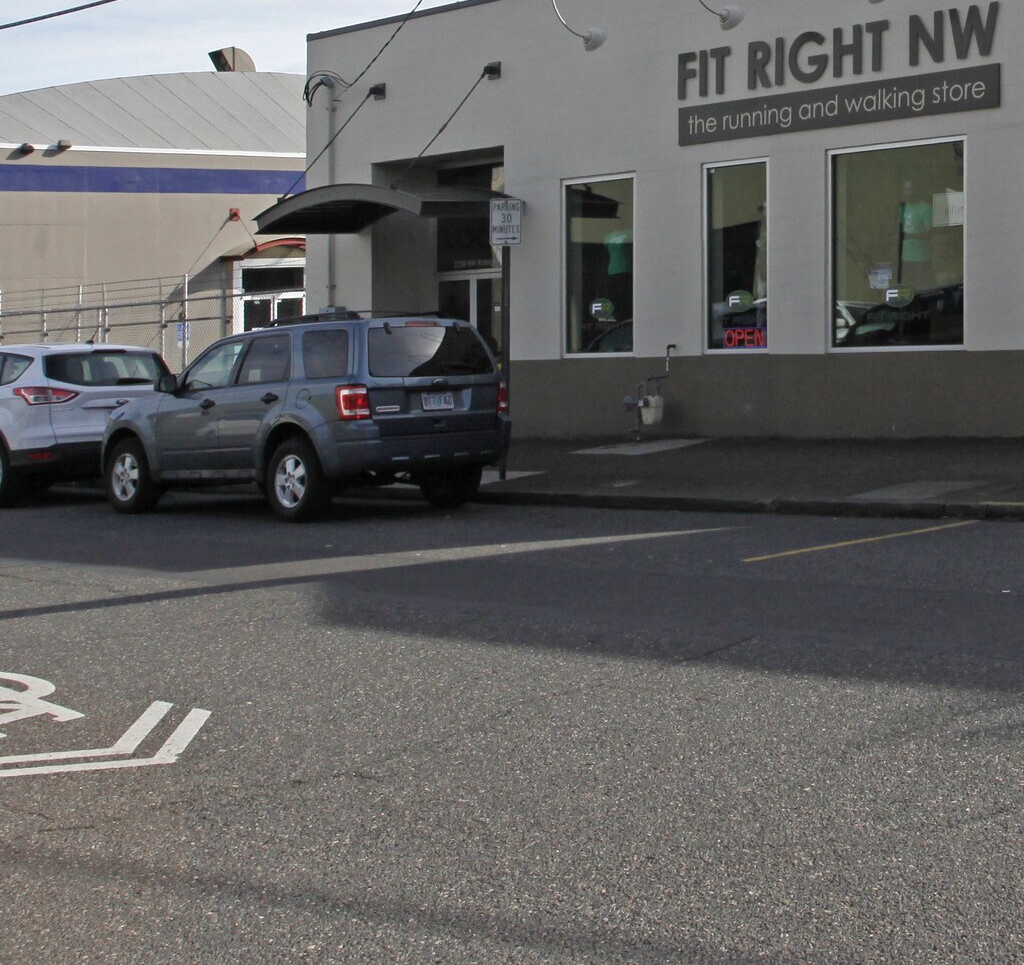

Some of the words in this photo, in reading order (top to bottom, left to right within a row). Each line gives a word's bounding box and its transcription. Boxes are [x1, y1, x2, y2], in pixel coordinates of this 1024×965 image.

[677, 46, 730, 100] FIT
[748, 20, 889, 90] RIGHT
[909, 1, 999, 66] NW
[688, 114, 717, 135] the
[722, 104, 792, 131] running
[798, 94, 838, 120] and
[843, 86, 926, 113] walking
[932, 80, 986, 103] store
[493, 202, 520, 212] PARKING
[501, 213, 512, 223] 30
[492, 224, 520, 234] MINUTES
[724, 329, 765, 347] OPEN
